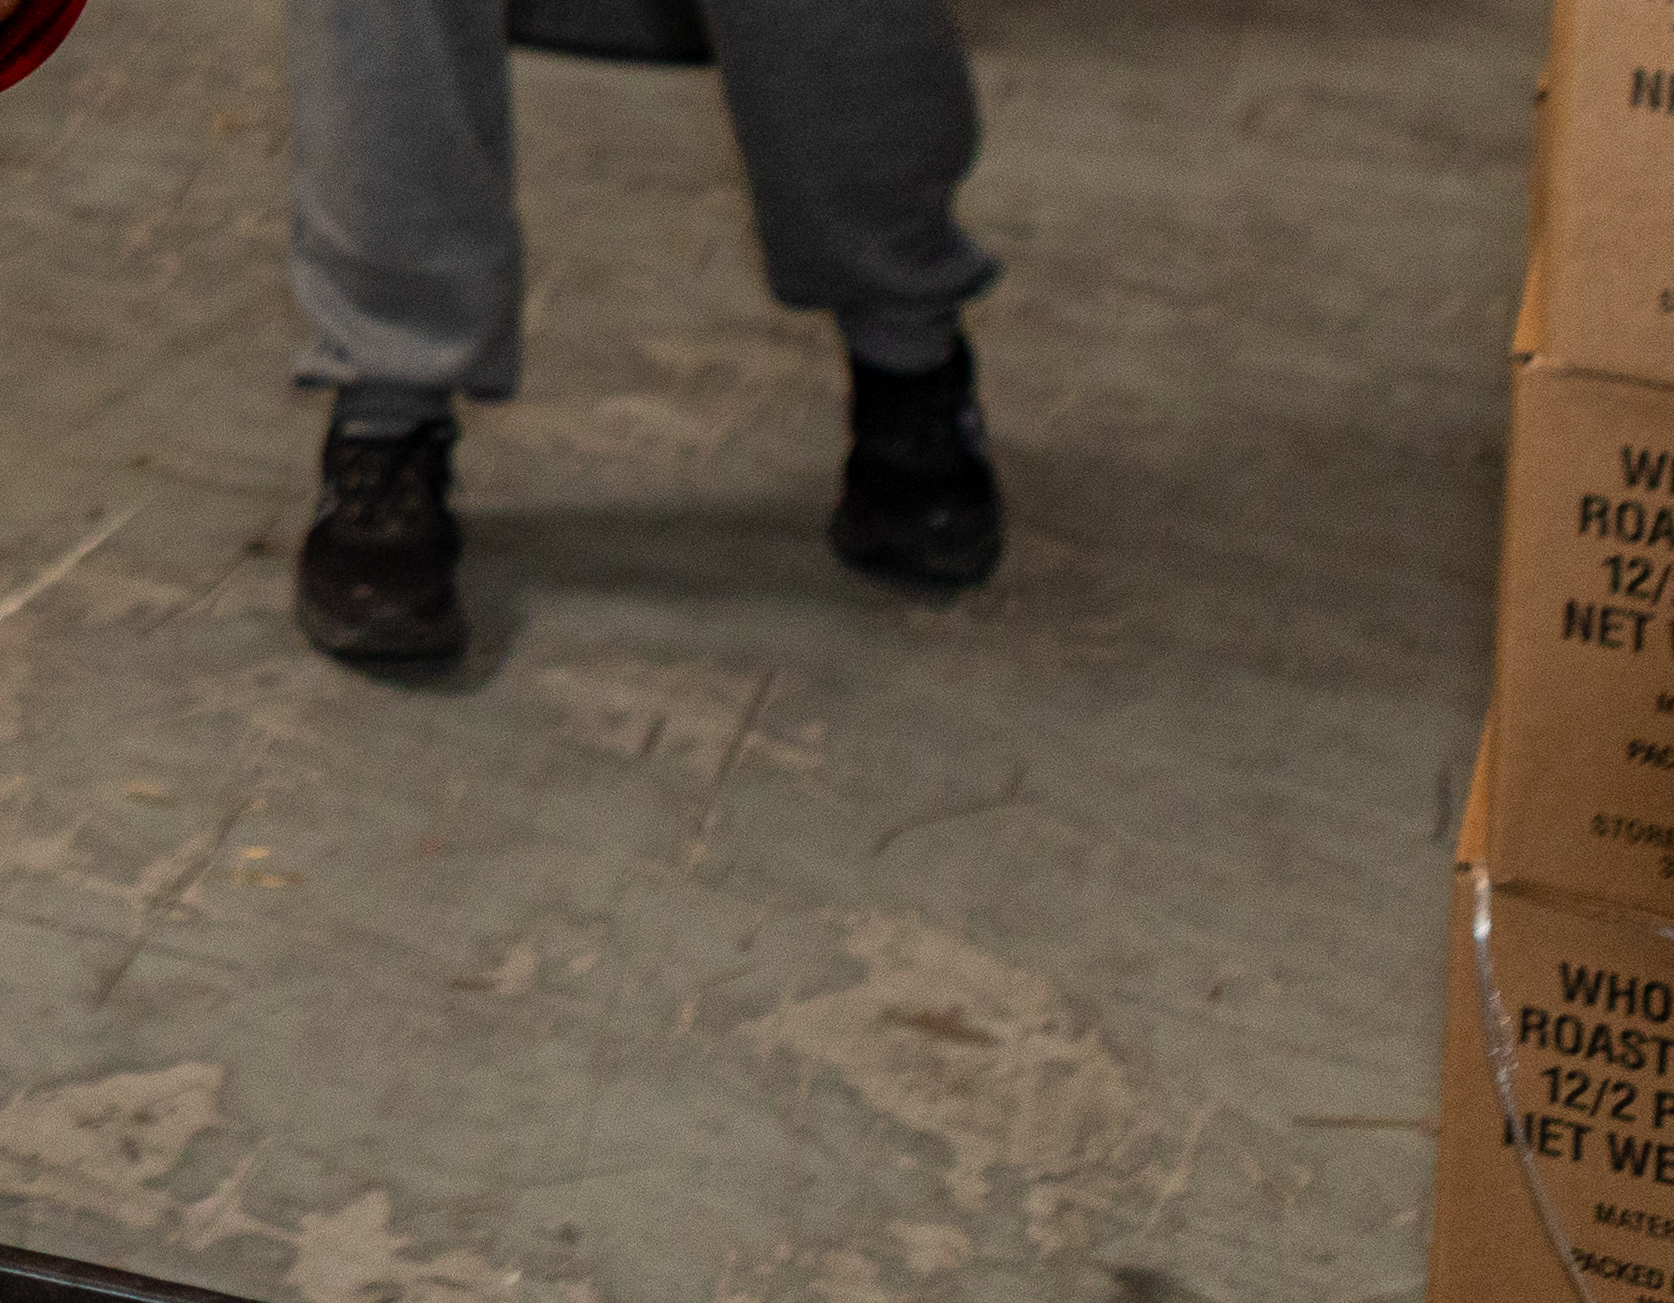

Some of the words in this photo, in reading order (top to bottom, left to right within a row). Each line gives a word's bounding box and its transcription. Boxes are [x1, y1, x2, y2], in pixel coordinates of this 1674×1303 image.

[1563, 599, 1653, 654] NET
[1519, 1006, 1674, 1078] ROAST
[1540, 1065, 1641, 1124] 12/2
[1502, 1112, 1592, 1163] NET
